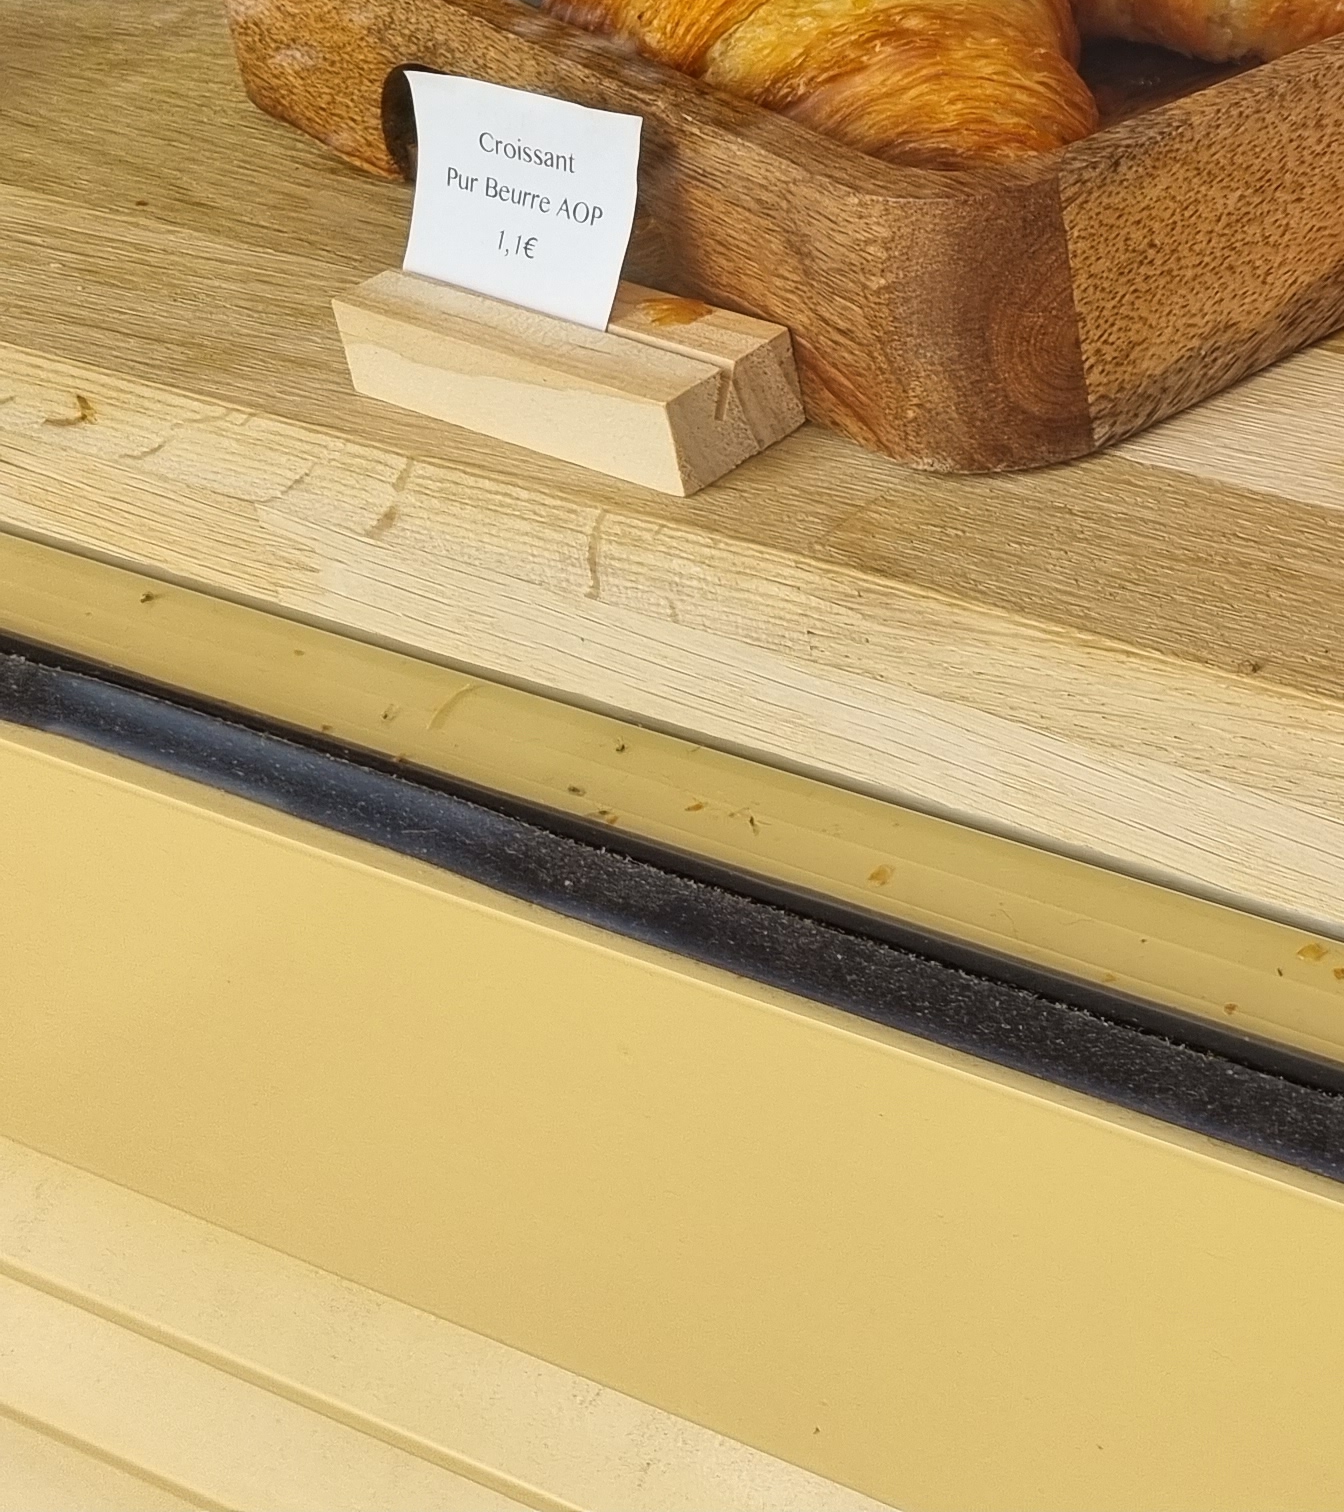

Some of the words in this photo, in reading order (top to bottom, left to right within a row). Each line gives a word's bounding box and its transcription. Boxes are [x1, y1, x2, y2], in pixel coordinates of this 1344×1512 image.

[479, 132, 575, 173] Croissant
[447, 167, 478, 192] Pur
[485, 177, 550, 213] Beurre
[556, 198, 603, 226] AOP
[498, 230, 538, 259] 1,1€
